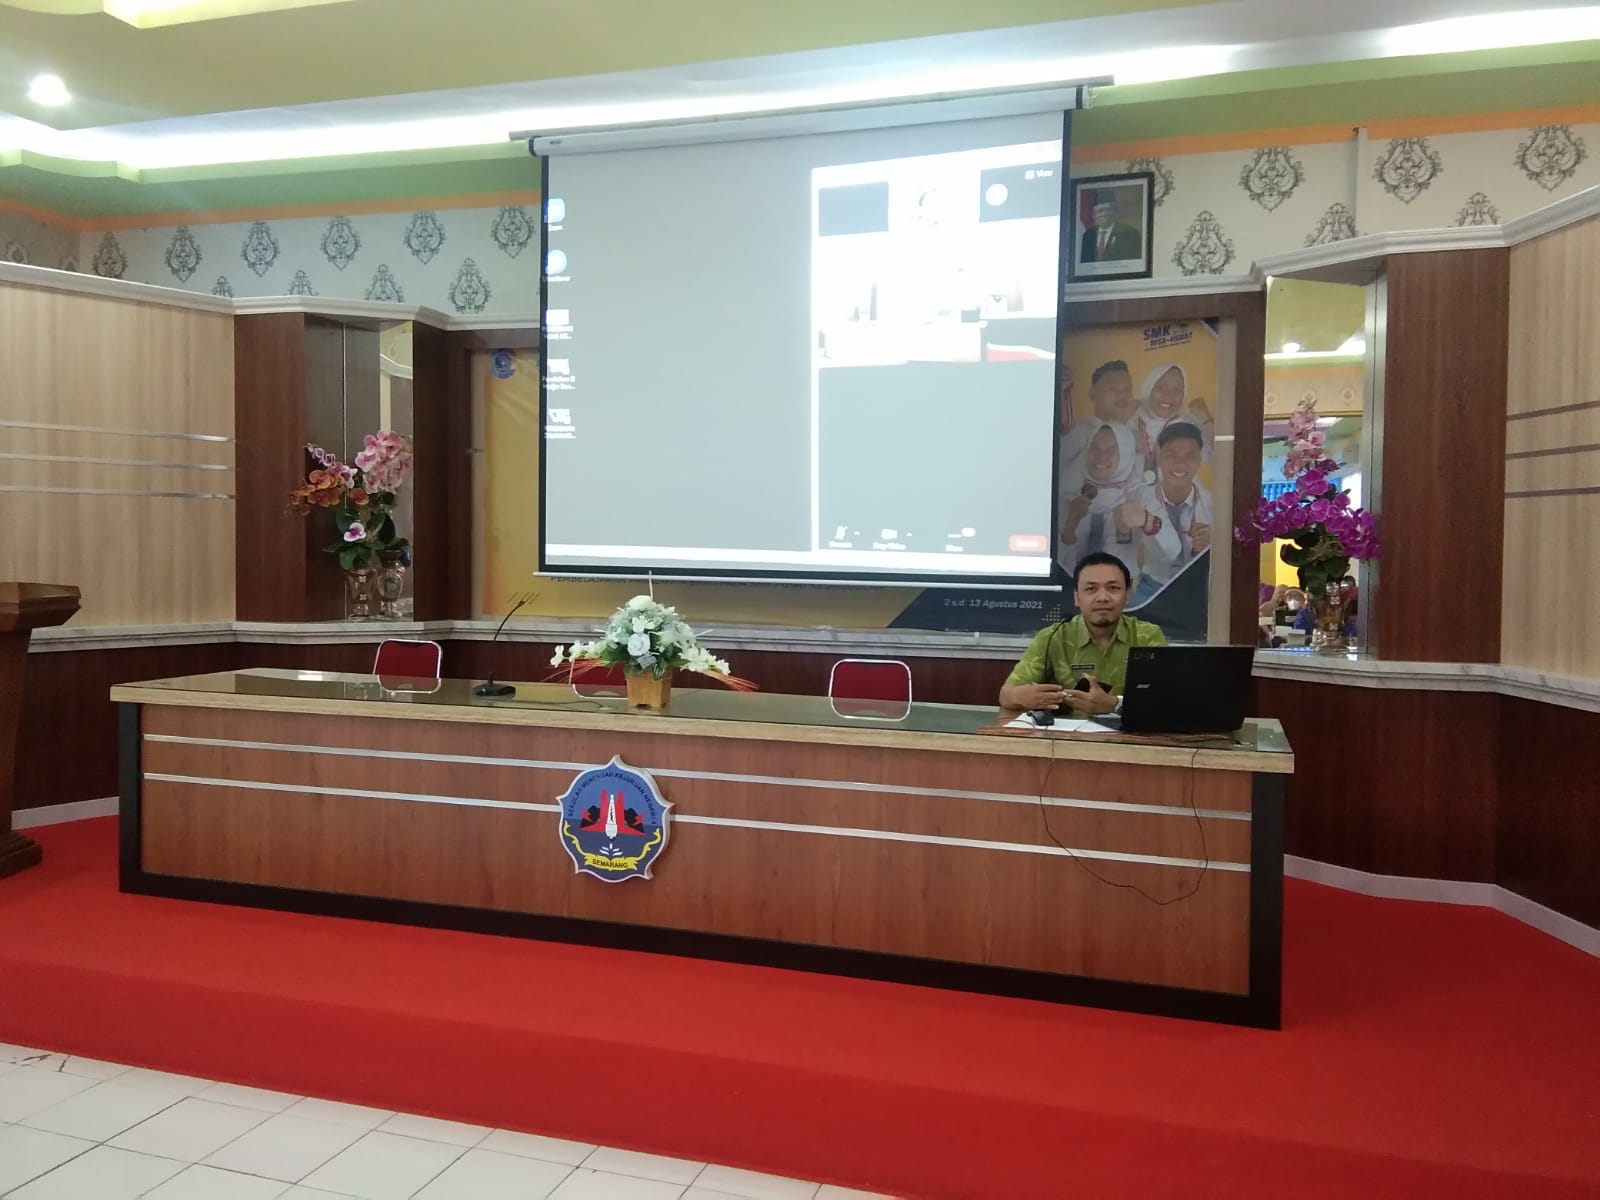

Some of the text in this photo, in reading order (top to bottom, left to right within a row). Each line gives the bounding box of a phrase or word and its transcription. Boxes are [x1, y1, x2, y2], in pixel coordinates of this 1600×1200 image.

[1144, 324, 1171, 340] SMK
[968, 599, 982, 607] 13
[983, 599, 1018, 610] Agustus
[1019, 600, 1043, 609] 2021
[592, 858, 628, 868] SEMARANG
